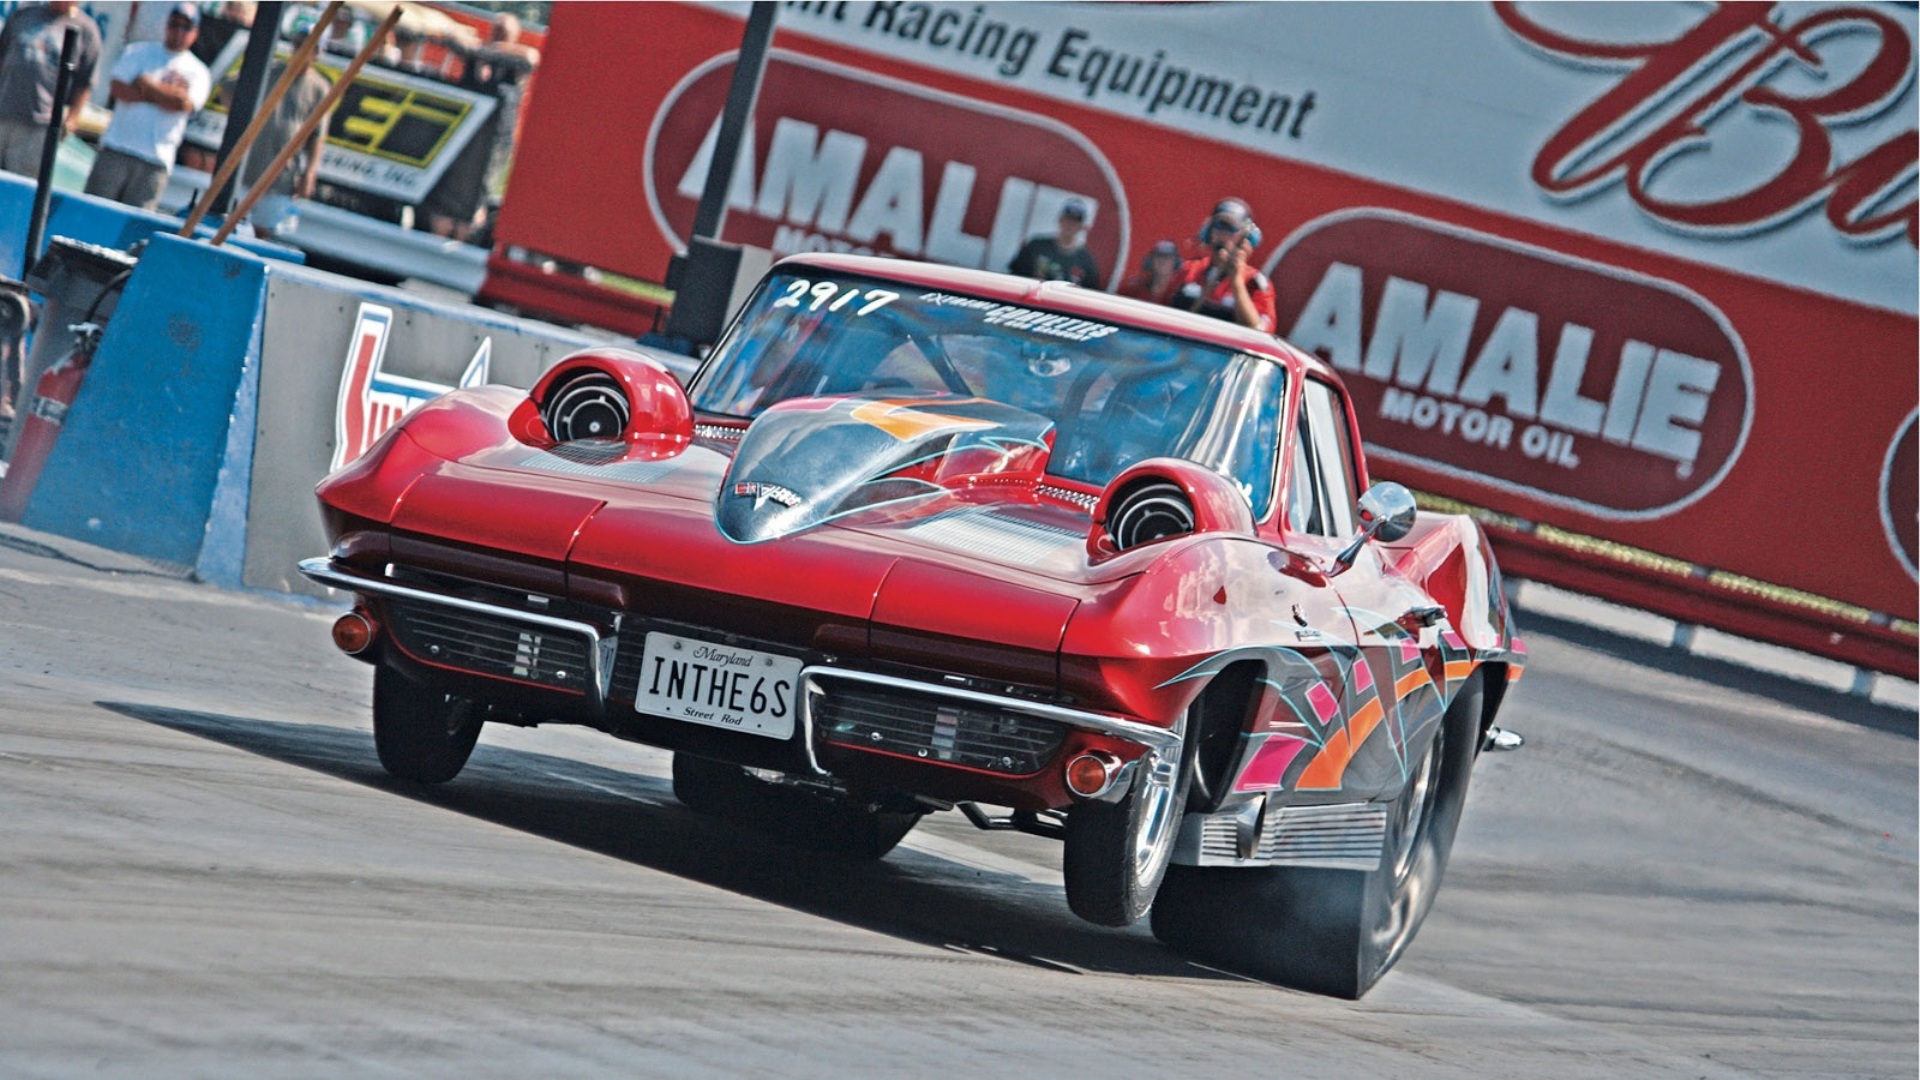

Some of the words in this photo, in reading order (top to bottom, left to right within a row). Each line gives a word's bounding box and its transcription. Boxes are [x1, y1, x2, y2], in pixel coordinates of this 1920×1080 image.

[862, 1, 1040, 77] Racing
[1047, 26, 1317, 140] Equipment
[773, 279, 900, 316] 2917
[985, 305, 1119, 338] CORVETTES
[1287, 261, 1722, 462] AMALIE
[1378, 387, 1513, 450] MOTOR
[1520, 425, 1581, 470] OIL
[693, 646, 753, 668] Maryland
[648, 655, 791, 718] INTHE6S
[683, 706, 715, 721] Street
[720, 713, 744, 726] Rod
